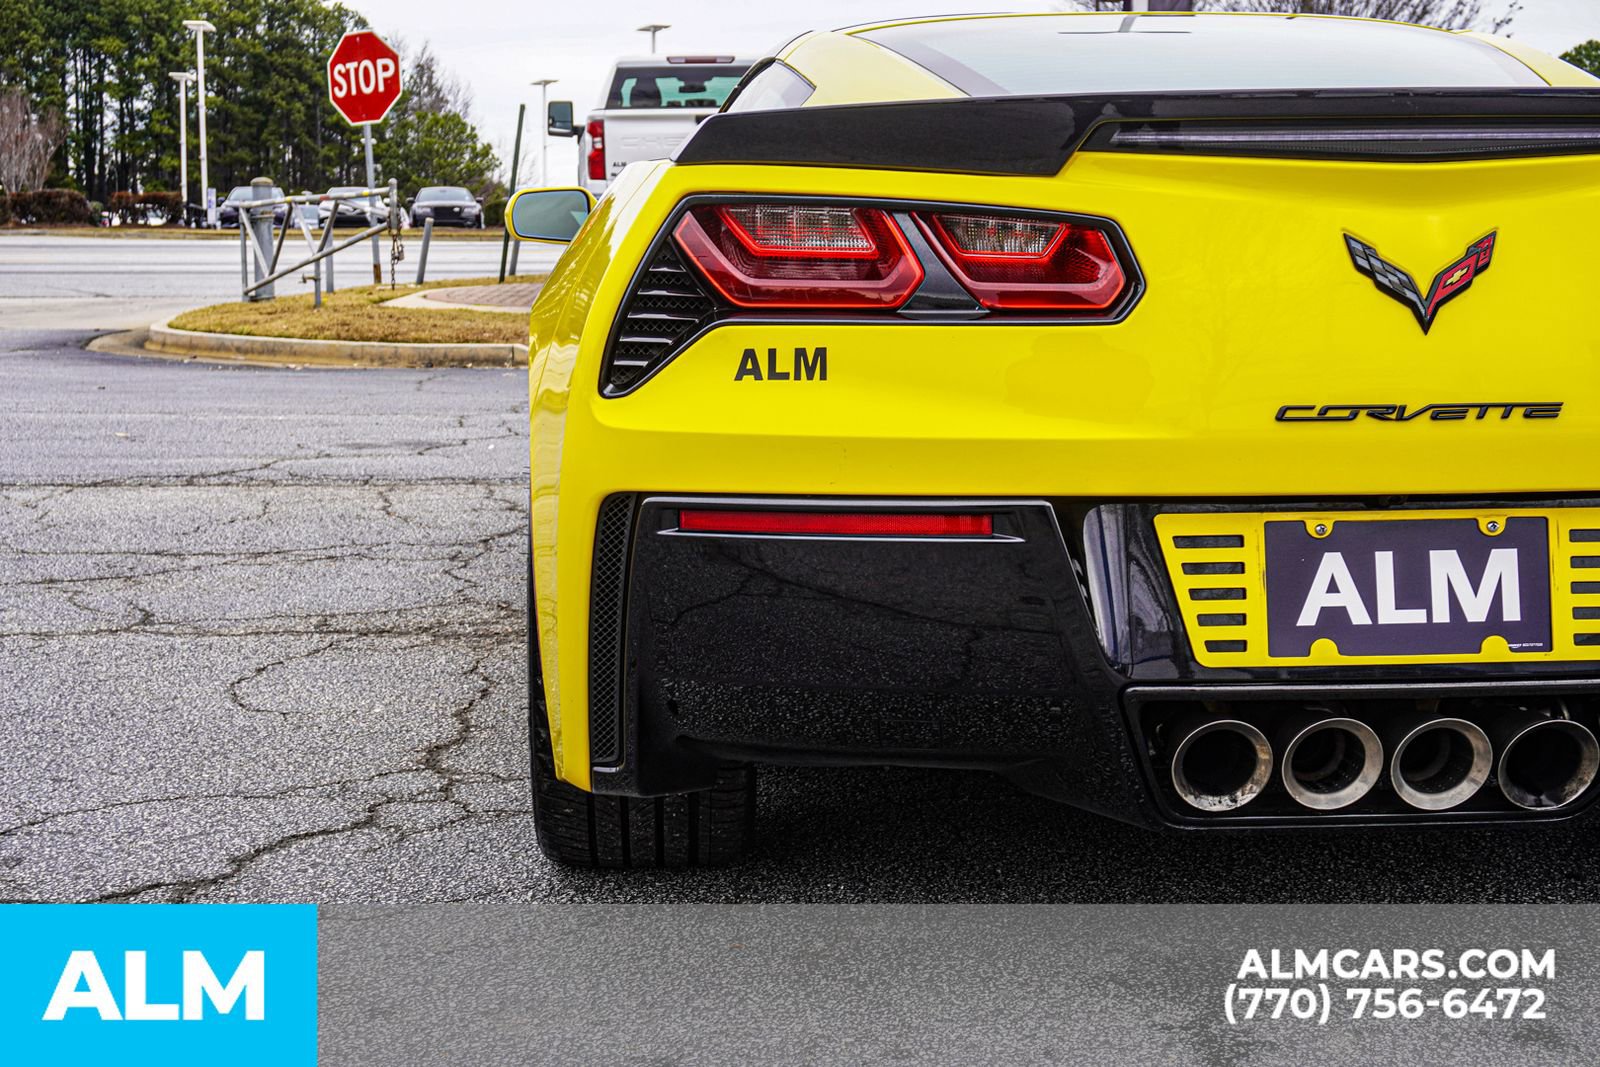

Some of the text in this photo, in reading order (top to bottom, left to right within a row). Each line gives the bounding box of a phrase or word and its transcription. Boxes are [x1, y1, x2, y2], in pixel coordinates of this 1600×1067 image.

[333, 57, 395, 98] STOP
[734, 347, 827, 381] ALM
[1275, 402, 1564, 423] CORVETTE
[1296, 548, 1521, 627] ALM
